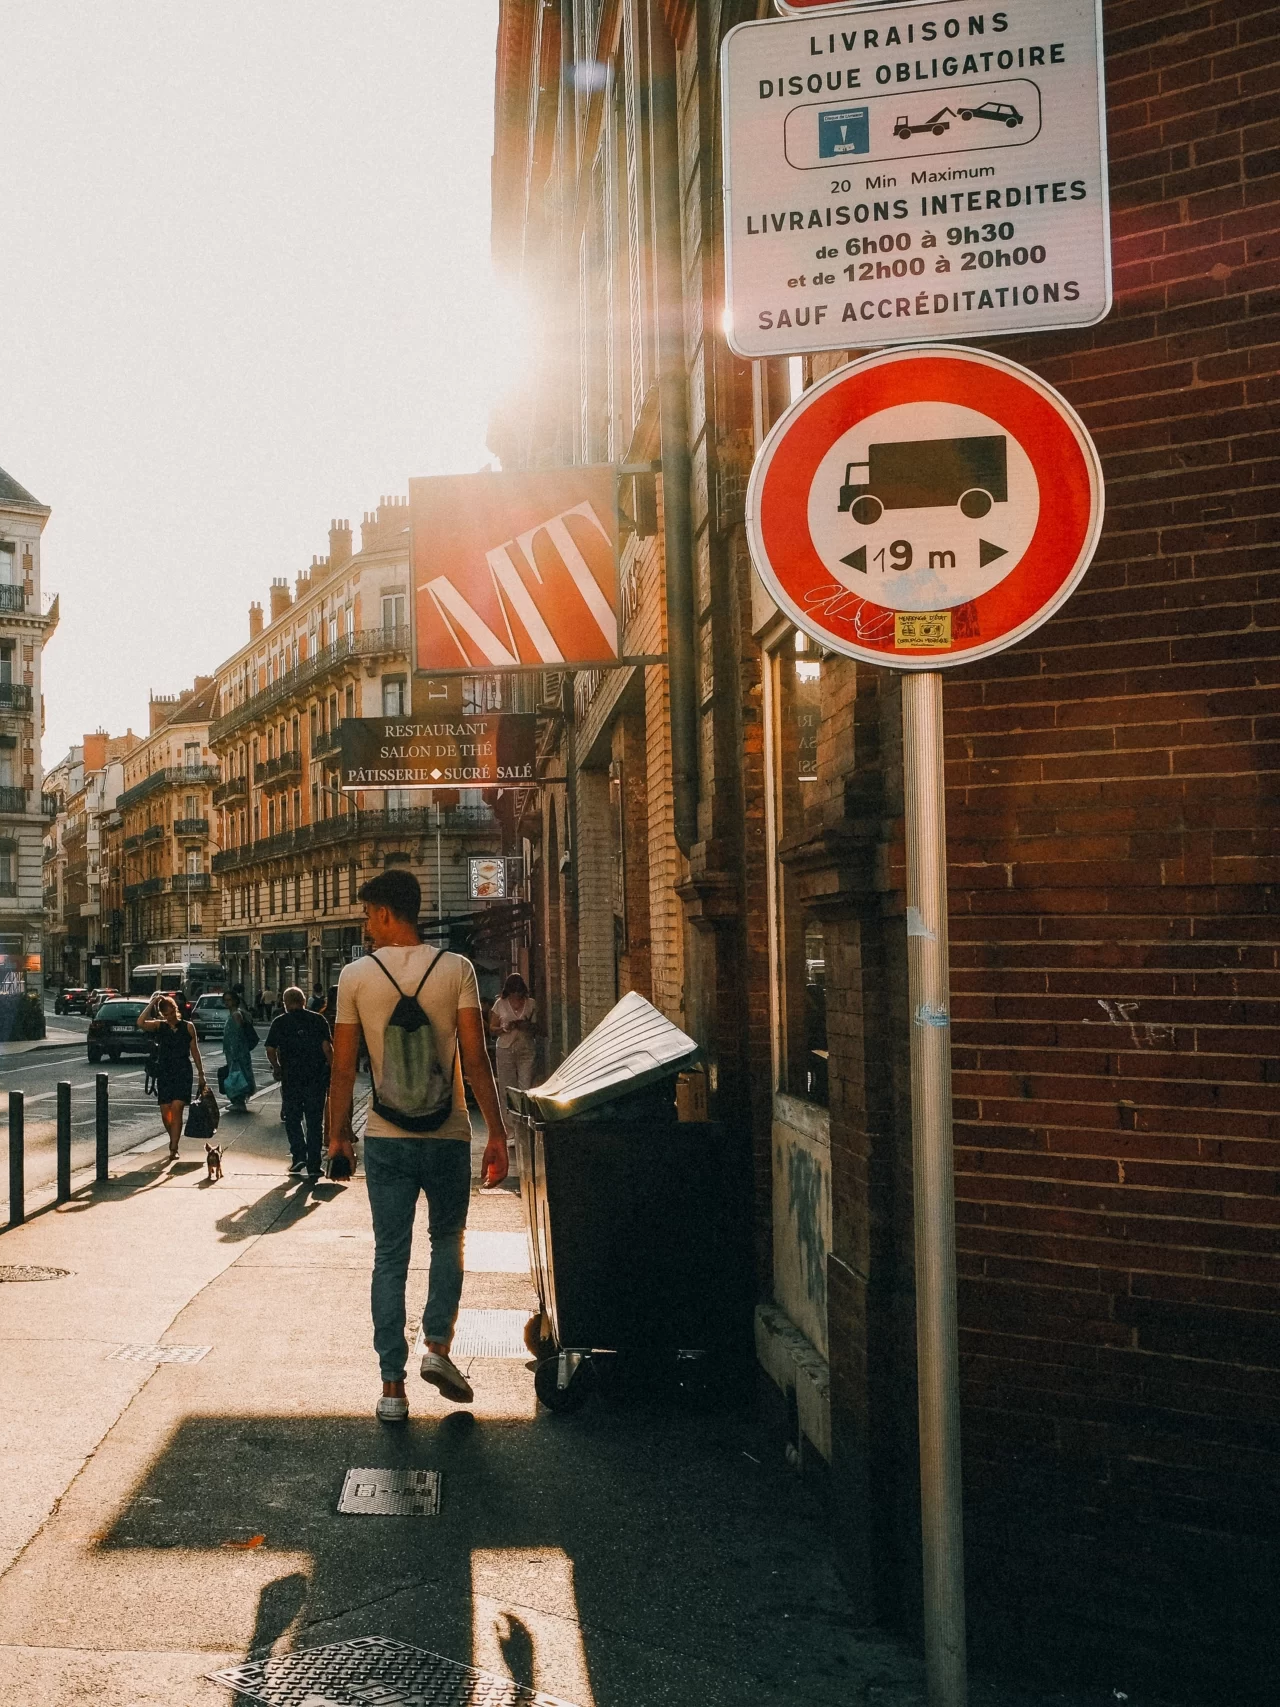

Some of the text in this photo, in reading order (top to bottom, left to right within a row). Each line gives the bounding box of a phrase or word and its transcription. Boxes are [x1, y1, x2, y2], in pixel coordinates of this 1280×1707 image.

[810, 12, 1009, 56] LIVRAISONS
[759, 43, 1066, 99] DISQUE OBLIGATOIRE
[830, 165, 995, 195] 20 Min Maximum
[746, 180, 1088, 235] LIVRAISONS INTERDITES
[815, 221, 1015, 261] de 6h00 à 9h30
[787, 245, 1047, 289] et de 12h00 à 20h00
[758, 280, 1080, 331] SAUF ACCRÉDITATIONS
[929, 550, 956, 568] m
[380, 741, 493, 759] SALON DE THÉ
[384, 723, 487, 738] RESTAURANT
[348, 763, 532, 782] PÂTISSERIE SUCRÉ SALÉ
